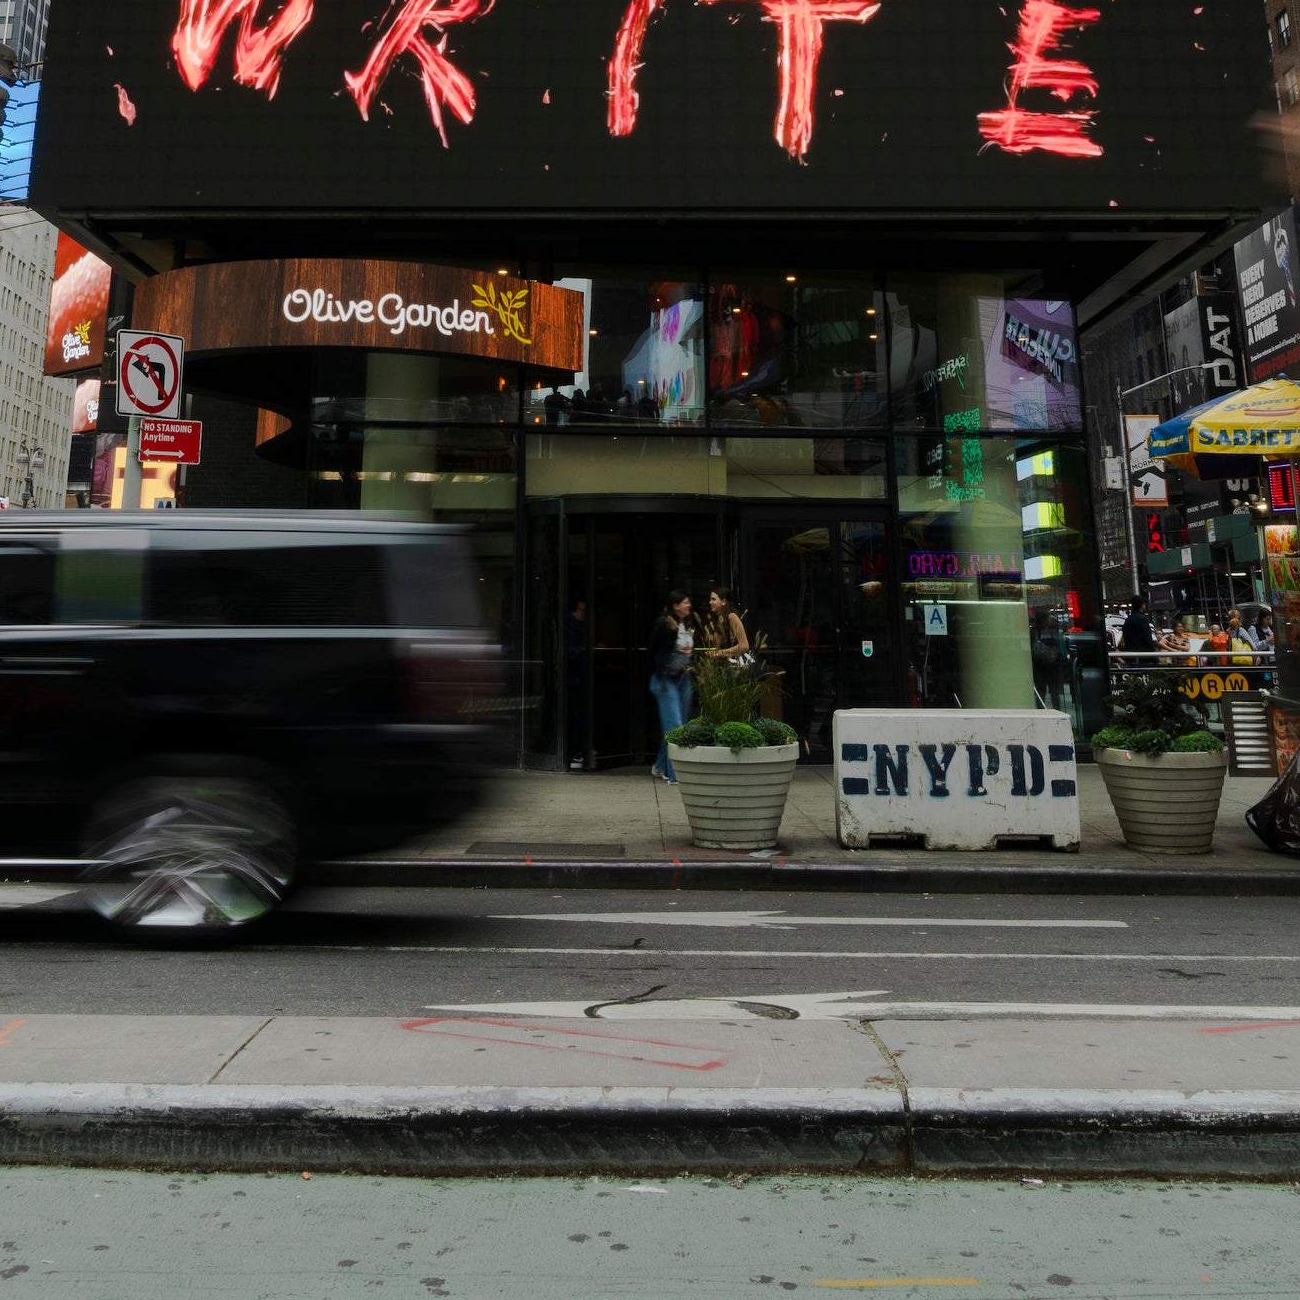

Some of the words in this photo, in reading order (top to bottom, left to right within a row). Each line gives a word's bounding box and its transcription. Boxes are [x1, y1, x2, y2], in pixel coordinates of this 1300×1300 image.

[1240, 258, 1265, 289] EVERY
[1242, 280, 1265, 308] HERO
[282, 288, 374, 324] Olive
[376, 292, 494, 336] Garden
[1244, 288, 1287, 327] DESERVES
[1247, 327, 1255, 346] A
[1253, 314, 1279, 343] HOME
[62, 332, 81, 349] Olive
[63, 342, 90, 362] Garden
[1221, 396, 1300, 412] SABRETT
[144, 422, 155, 432] NO
[156, 423, 193, 434] STANDING
[144, 433, 175, 443] Anytime
[929, 608, 943, 625] A
[1207, 679, 1218, 694] R
[1227, 679, 1245, 691] W
[872, 743, 1045, 797] NYPD
